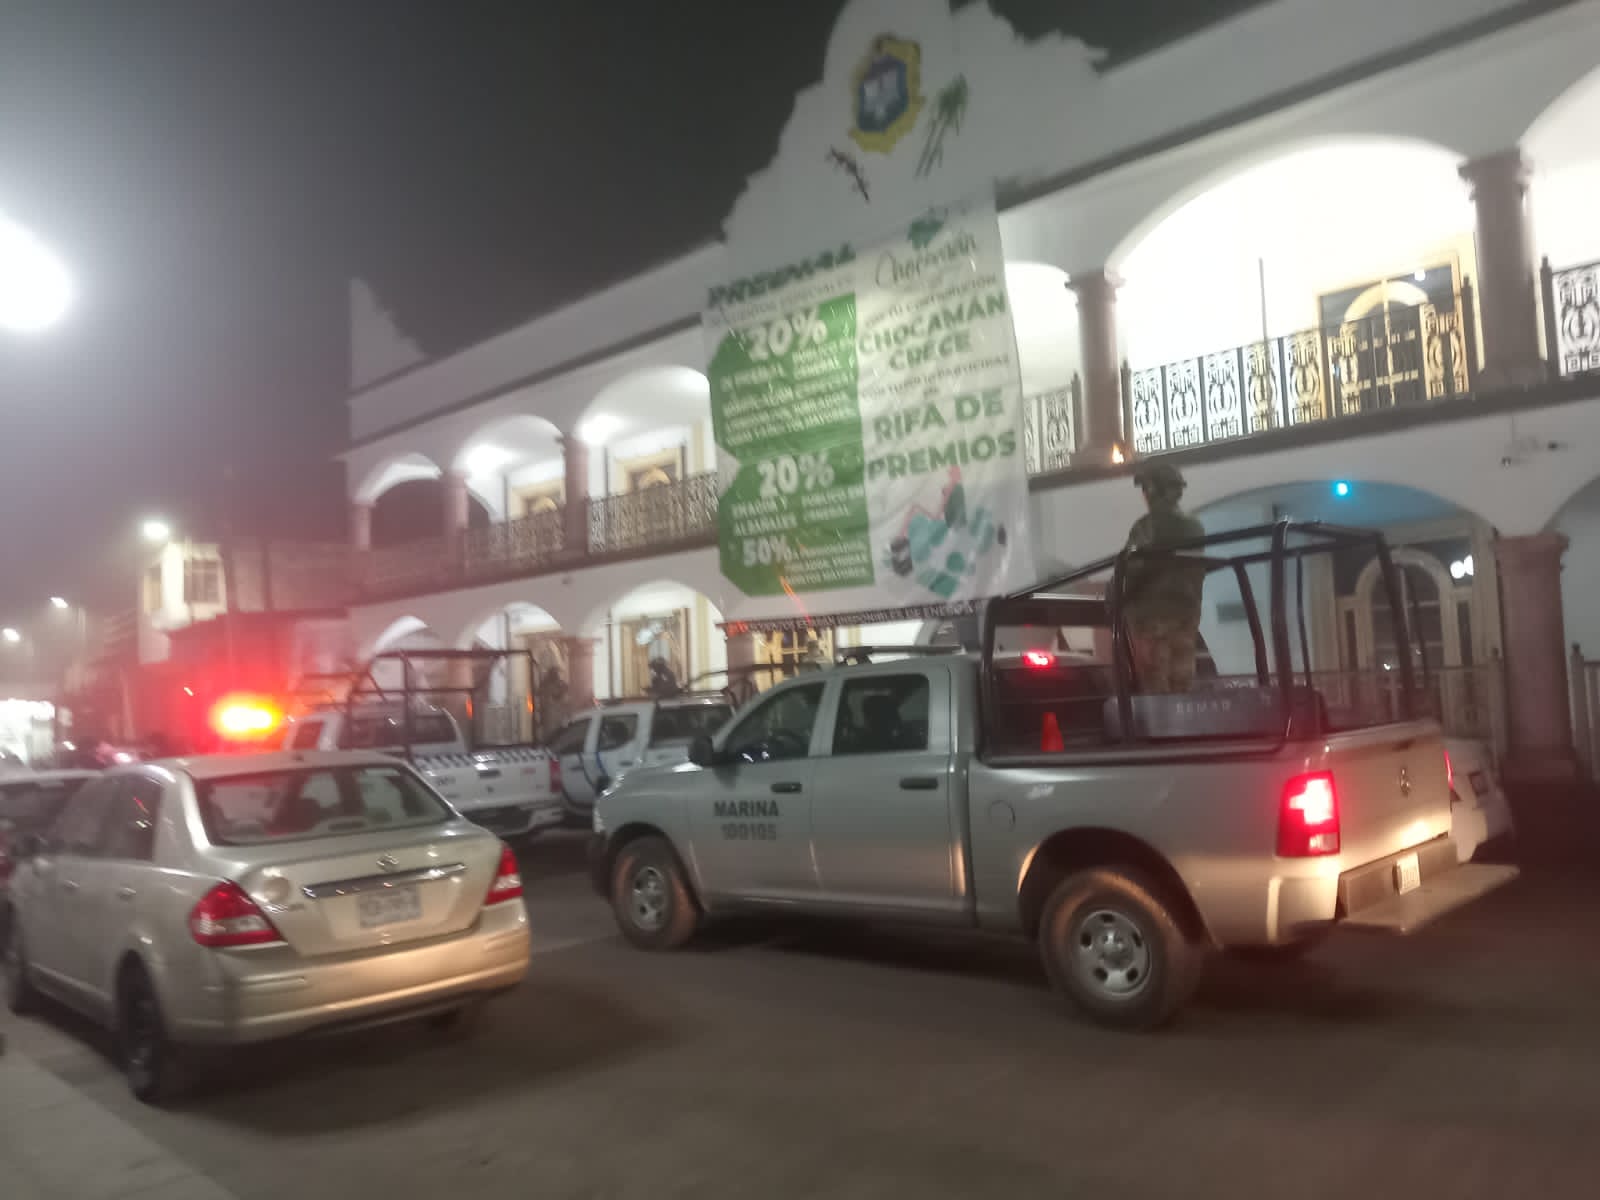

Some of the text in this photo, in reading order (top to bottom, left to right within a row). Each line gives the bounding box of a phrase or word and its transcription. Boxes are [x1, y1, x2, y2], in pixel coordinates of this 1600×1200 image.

[872, 402, 946, 443] RIFA
[954, 388, 1004, 422] DE
[757, 453, 834, 497] 20%
[867, 430, 1017, 479] PREMIOS
[713, 800, 779, 817] MARINA
